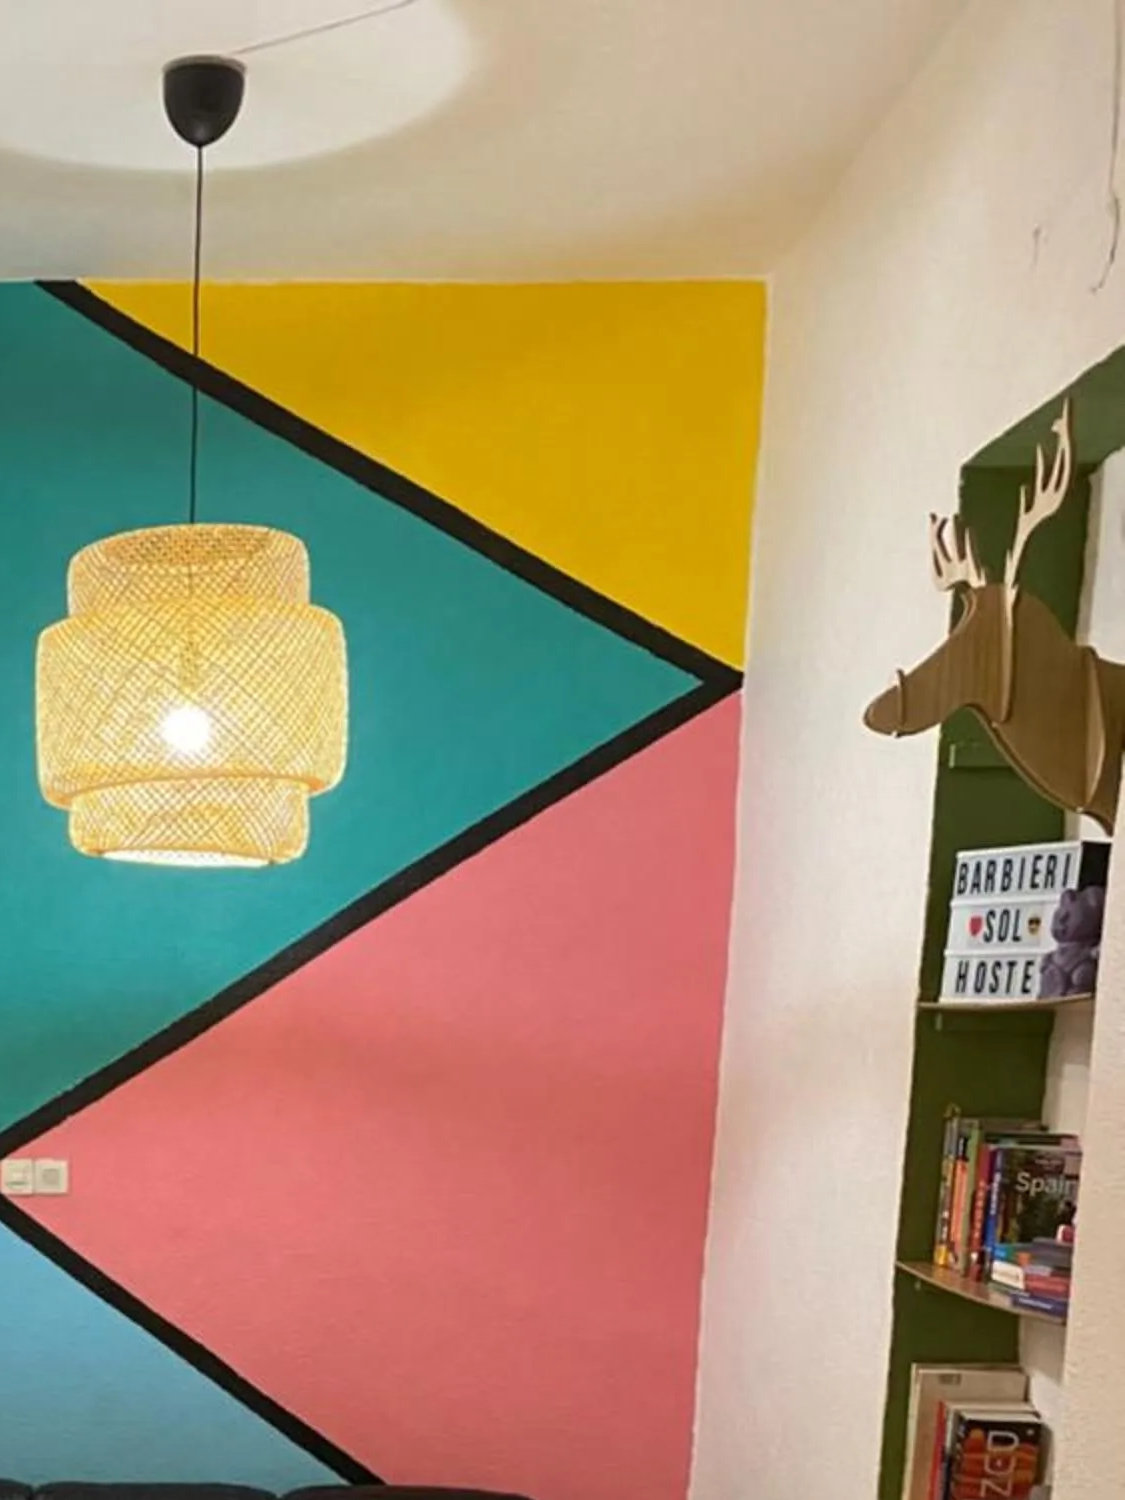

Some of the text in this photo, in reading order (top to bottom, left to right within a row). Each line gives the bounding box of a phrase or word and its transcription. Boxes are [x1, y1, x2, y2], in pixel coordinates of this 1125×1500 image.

[956, 853, 1072, 896] BARBIERI
[983, 908, 1022, 943] SOL
[955, 960, 1036, 994] HOSTE
